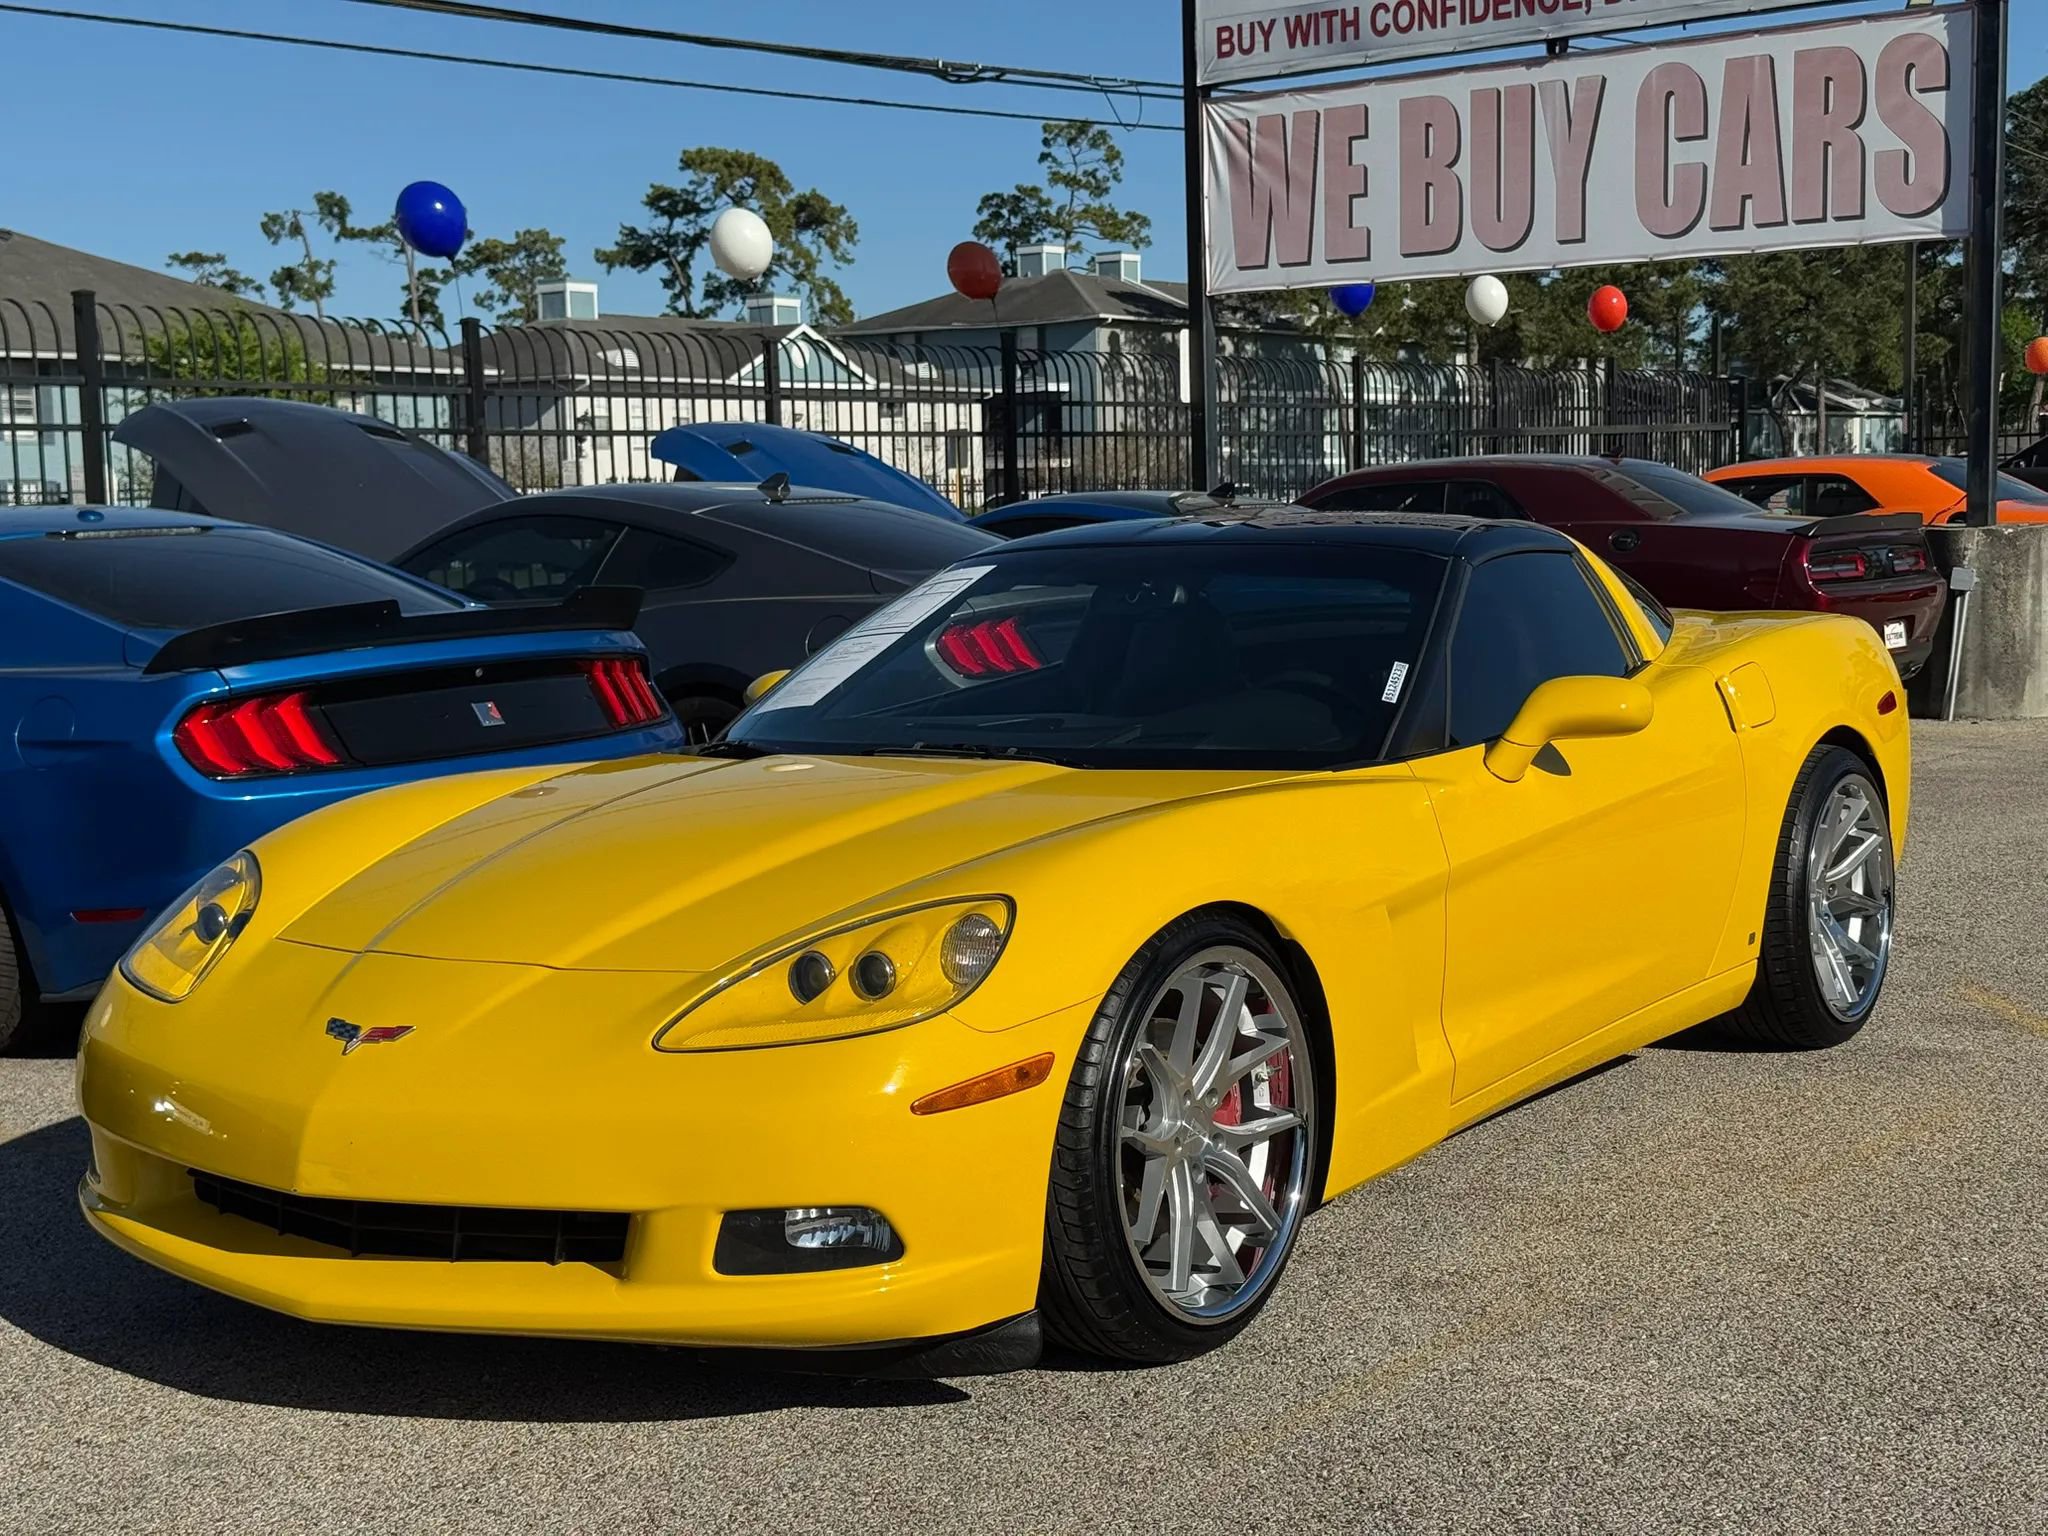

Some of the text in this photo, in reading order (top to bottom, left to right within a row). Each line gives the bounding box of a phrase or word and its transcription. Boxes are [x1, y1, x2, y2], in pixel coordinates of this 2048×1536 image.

[1216, 18, 1277, 59] BUY
[1284, 6, 1360, 49] WITH
[1227, 32, 1950, 270] WE BUY CARS
